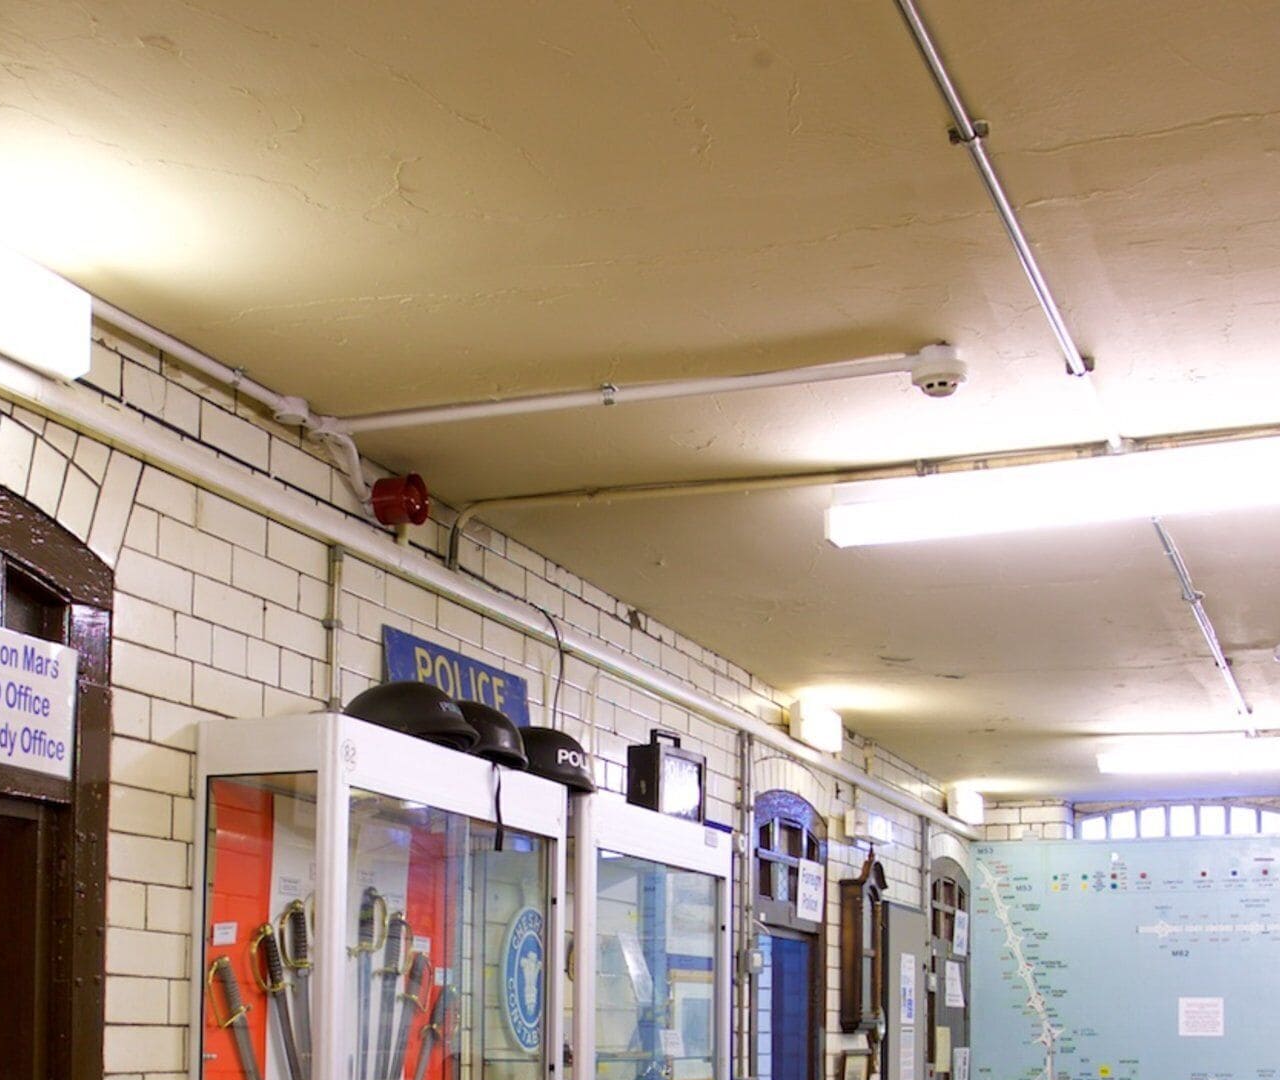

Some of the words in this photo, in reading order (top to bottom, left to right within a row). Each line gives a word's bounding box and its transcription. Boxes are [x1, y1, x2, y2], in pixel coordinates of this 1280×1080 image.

[0, 645, 18, 669] on
[23, 645, 59, 680] Mars
[414, 646, 508, 712] POLICE
[6, 681, 50, 717] Office
[21, 727, 65, 761] Office
[557, 749, 589, 770] POLI
